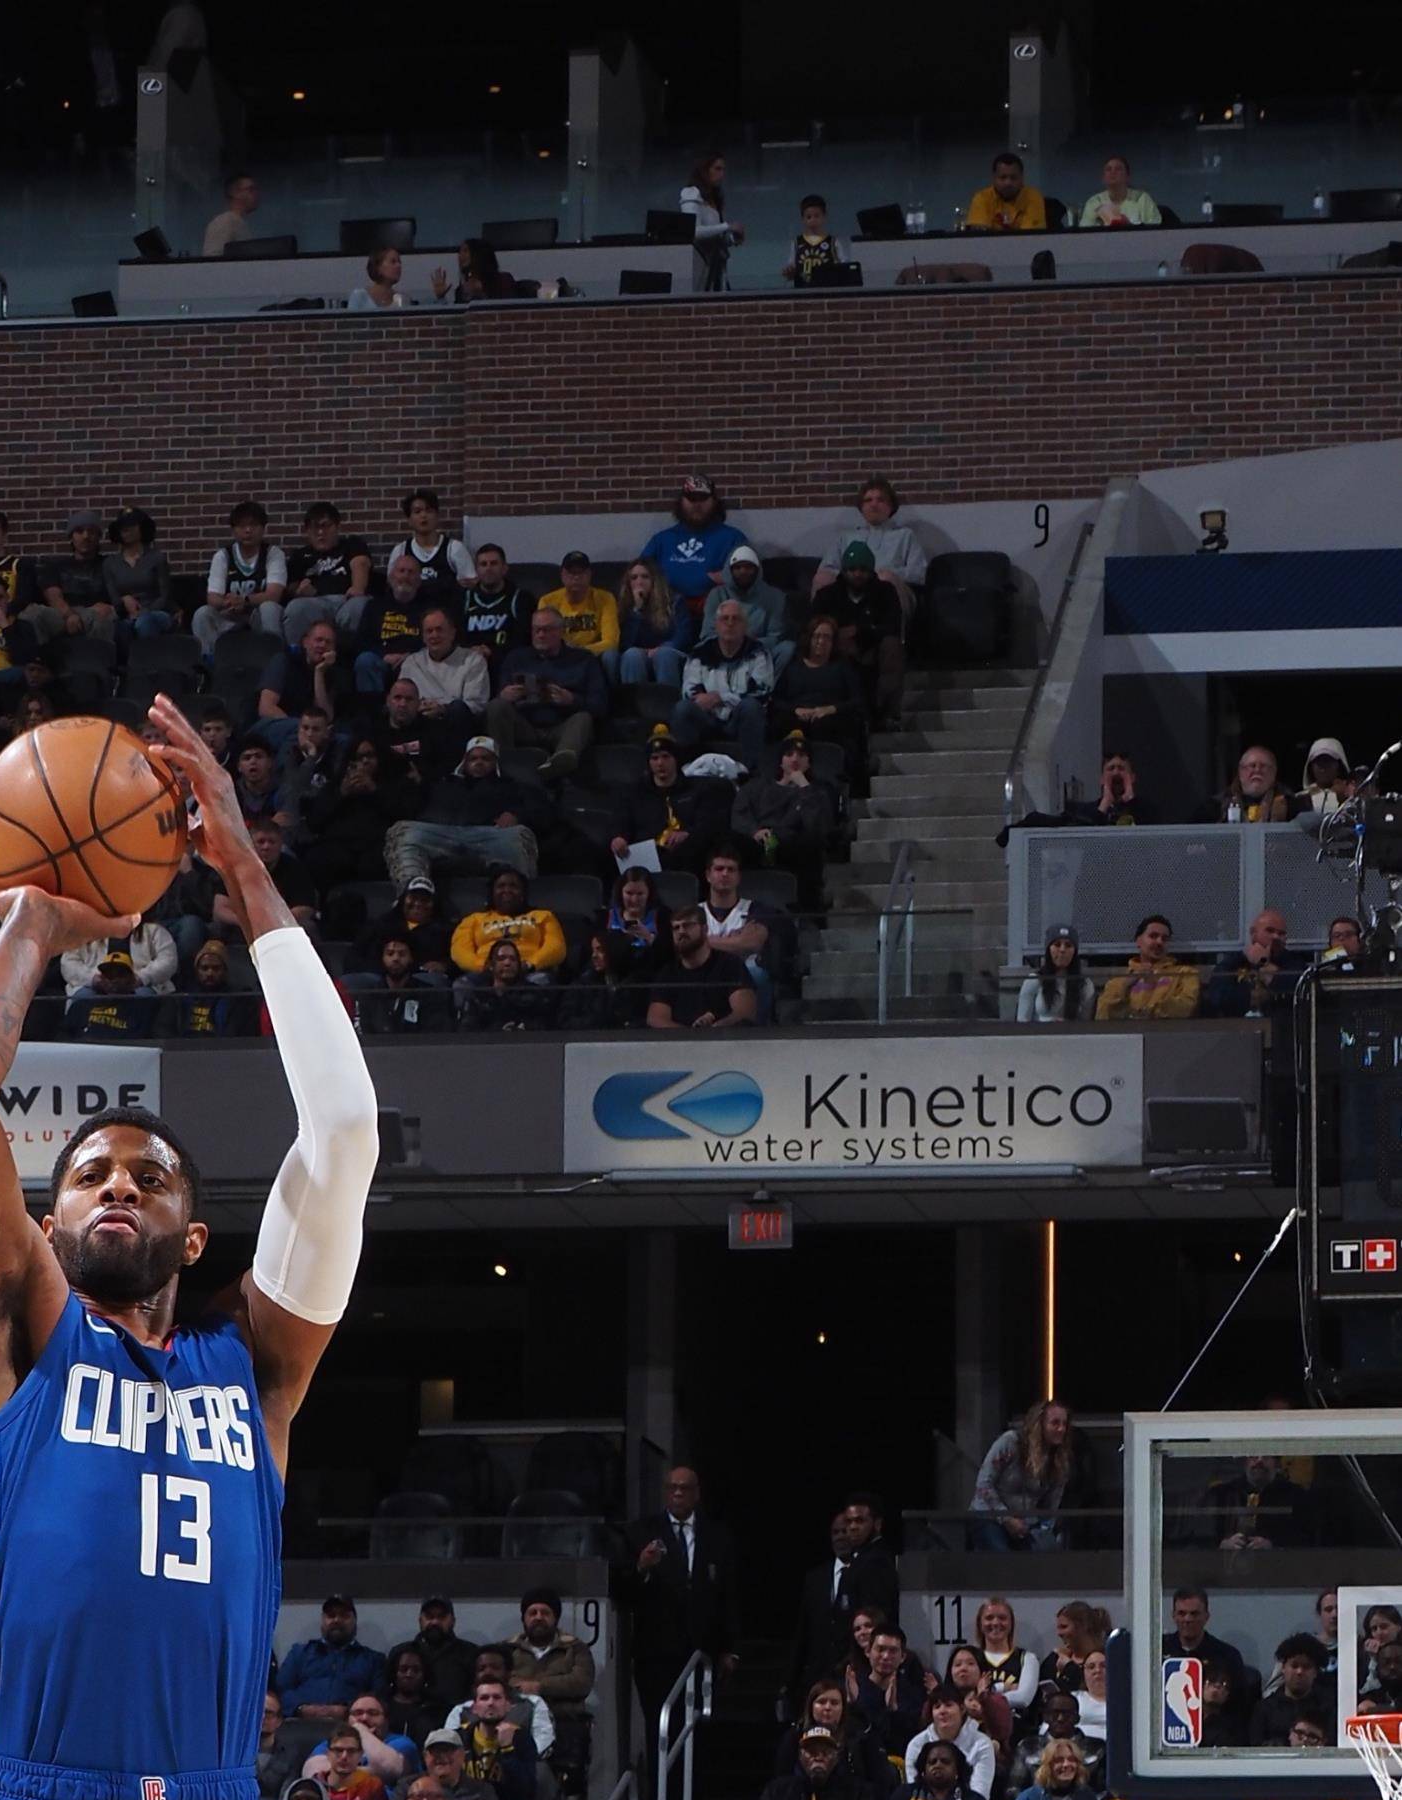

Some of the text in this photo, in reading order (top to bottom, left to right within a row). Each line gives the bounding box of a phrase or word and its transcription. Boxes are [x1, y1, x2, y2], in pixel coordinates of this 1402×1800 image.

[1033, 504, 1049, 548] 9
[467, 614, 507, 632] INDY
[803, 1070, 1113, 1130] Kinetico
[704, 1131, 1015, 1165] water systems
[741, 1212, 783, 1242] EXIT
[61, 1363, 256, 1471] CLIPPERS
[140, 1473, 211, 1584] 13
[584, 1598, 600, 1647] 9
[934, 1595, 967, 1645] 11
[1167, 1725, 1188, 1740] NBA
